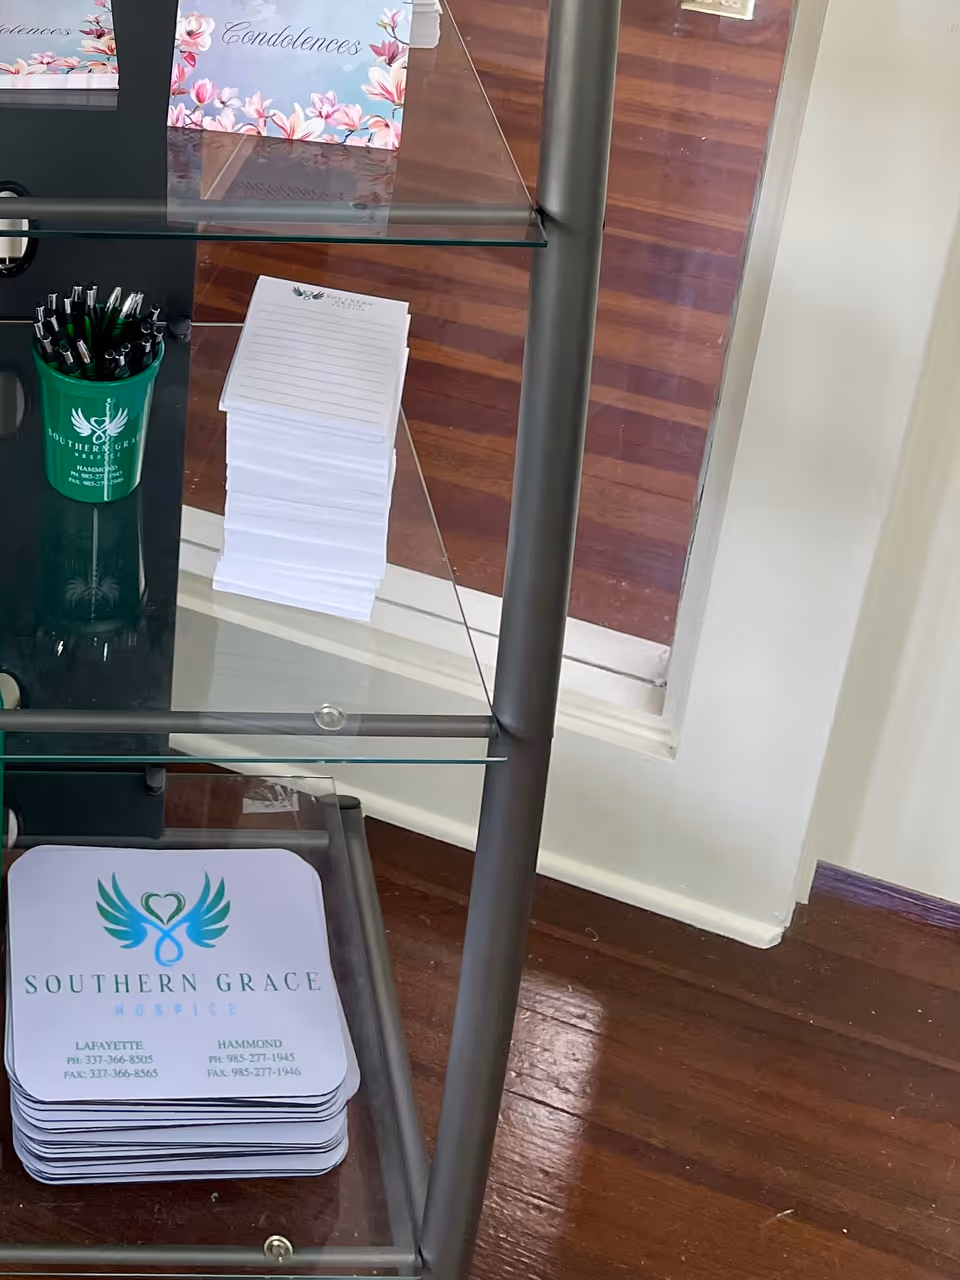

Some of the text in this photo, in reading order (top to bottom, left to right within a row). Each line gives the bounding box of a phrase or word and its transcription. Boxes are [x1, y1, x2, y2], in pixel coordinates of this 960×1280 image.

[221, 21, 364, 56] Condolences
[24, 971, 322, 995] SOUTHERN GRACE
[114, 1002, 238, 1017] HOSPICE
[75, 1040, 144, 1051] LAFAYETTE
[217, 1039, 283, 1050] HAMMOND
[66, 1054, 154, 1065] PH: 337-366-8505
[208, 1053, 296, 1064] PH: 985-277-1945
[63, 1068, 159, 1079] FAX: 337-366-8565
[207, 1067, 302, 1078] FAX: 985-277-1946
